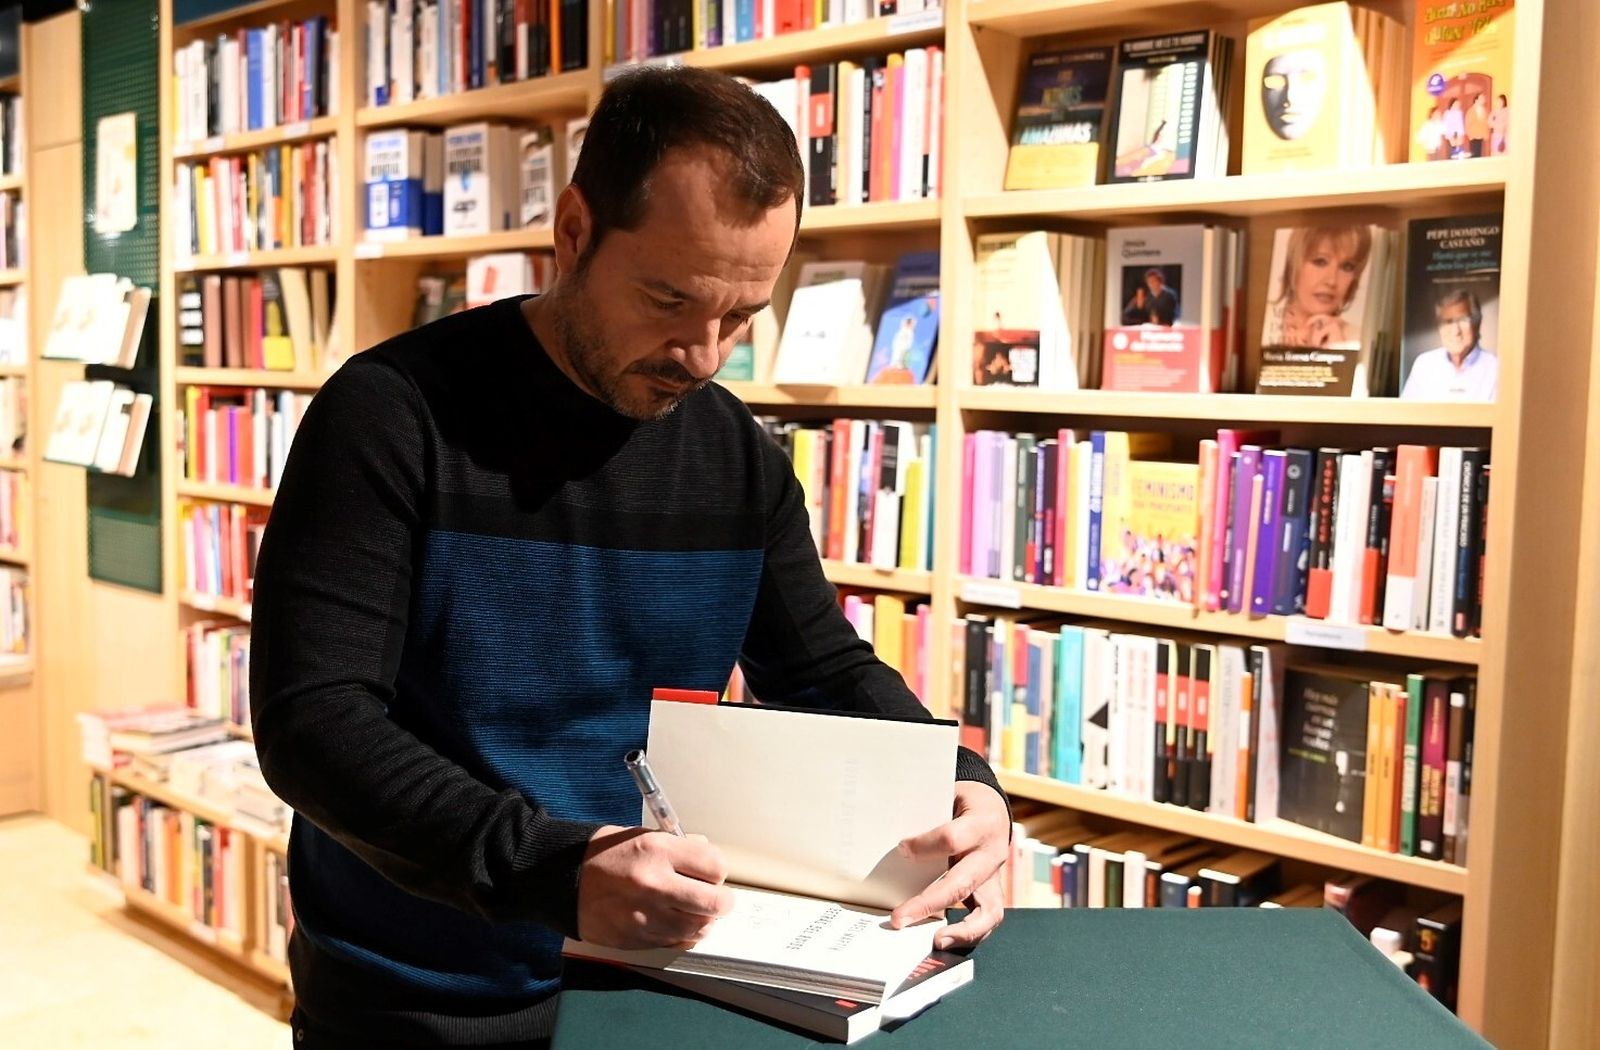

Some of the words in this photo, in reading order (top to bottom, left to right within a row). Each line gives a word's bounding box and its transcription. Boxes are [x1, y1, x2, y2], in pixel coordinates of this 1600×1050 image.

[1426, 229, 1449, 240] PEPE
[1450, 226, 1500, 238] DOMINGO
[1439, 237, 1487, 249] CASTAÑO
[1132, 478, 1194, 500] FEMINISMO
